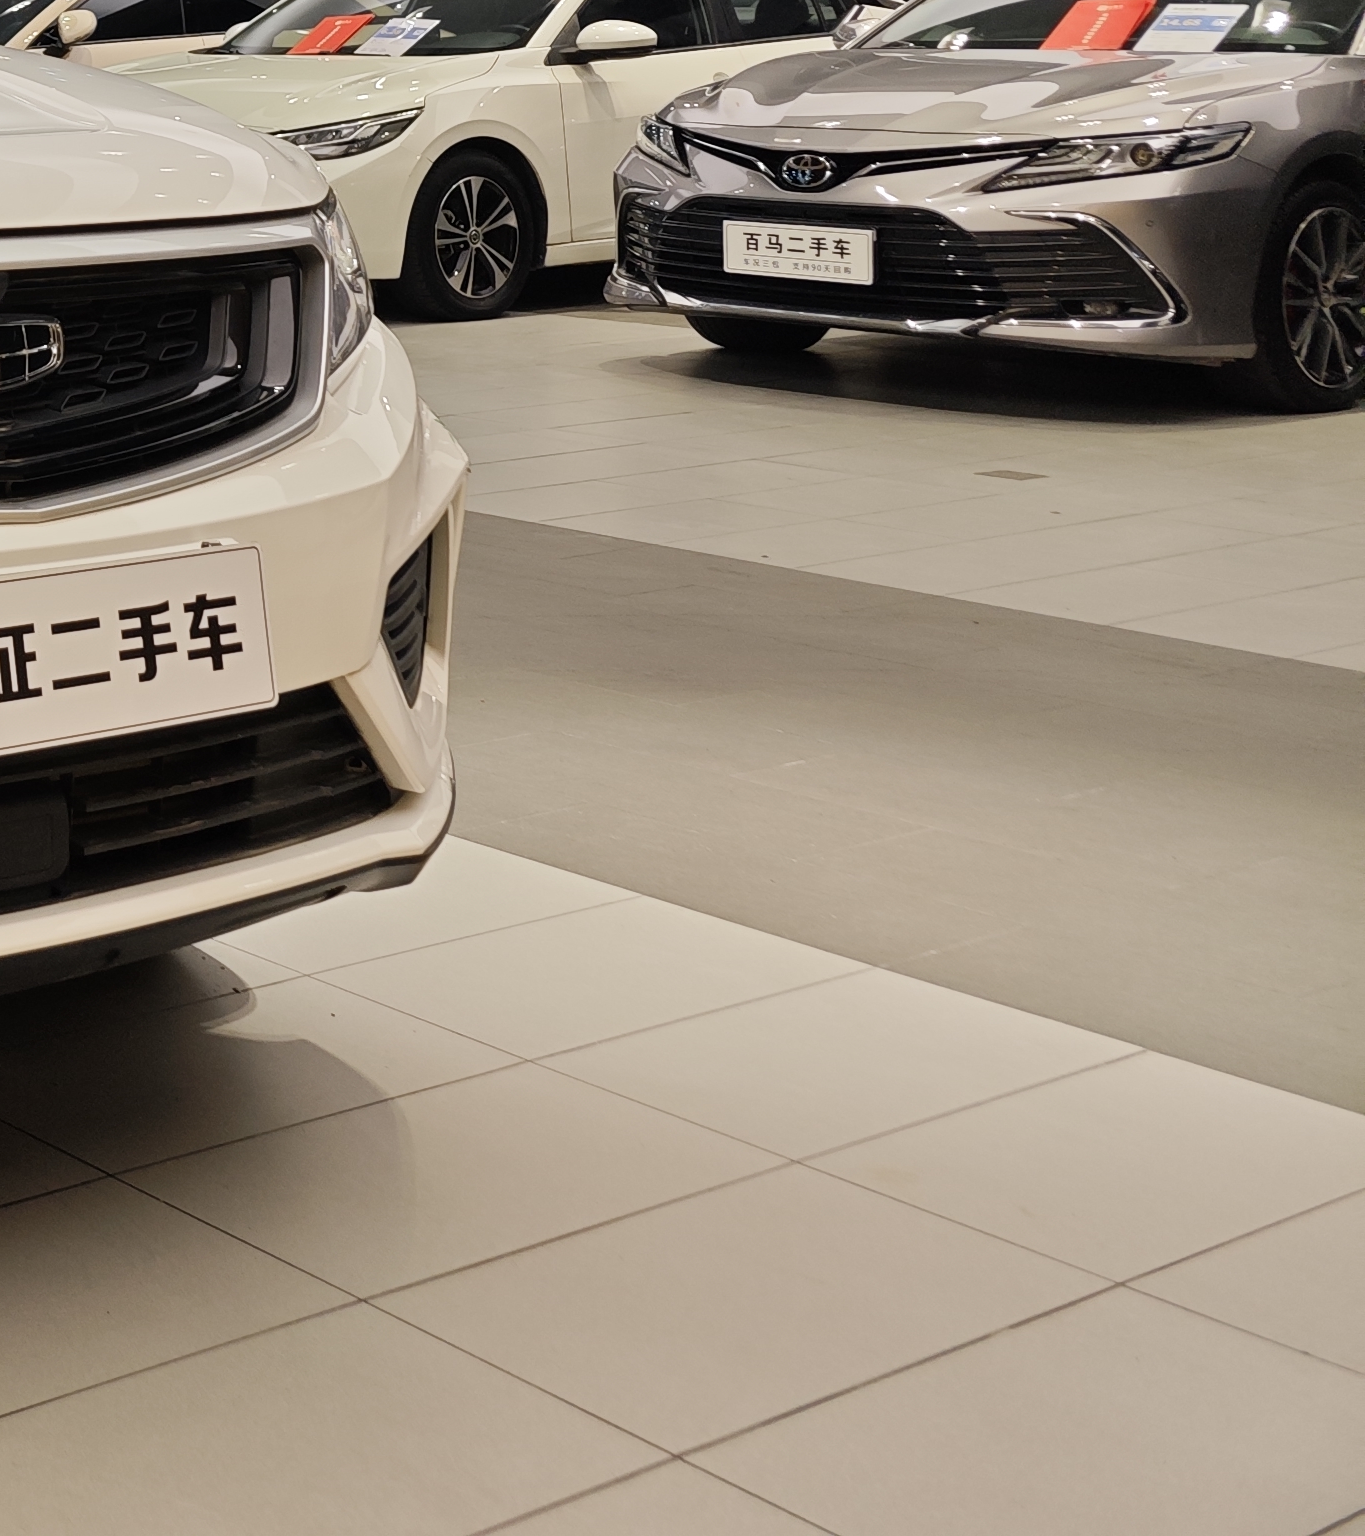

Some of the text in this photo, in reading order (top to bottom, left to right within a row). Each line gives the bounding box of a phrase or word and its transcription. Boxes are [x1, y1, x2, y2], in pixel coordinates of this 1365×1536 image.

[743, 232, 851, 259] 百马二手车
